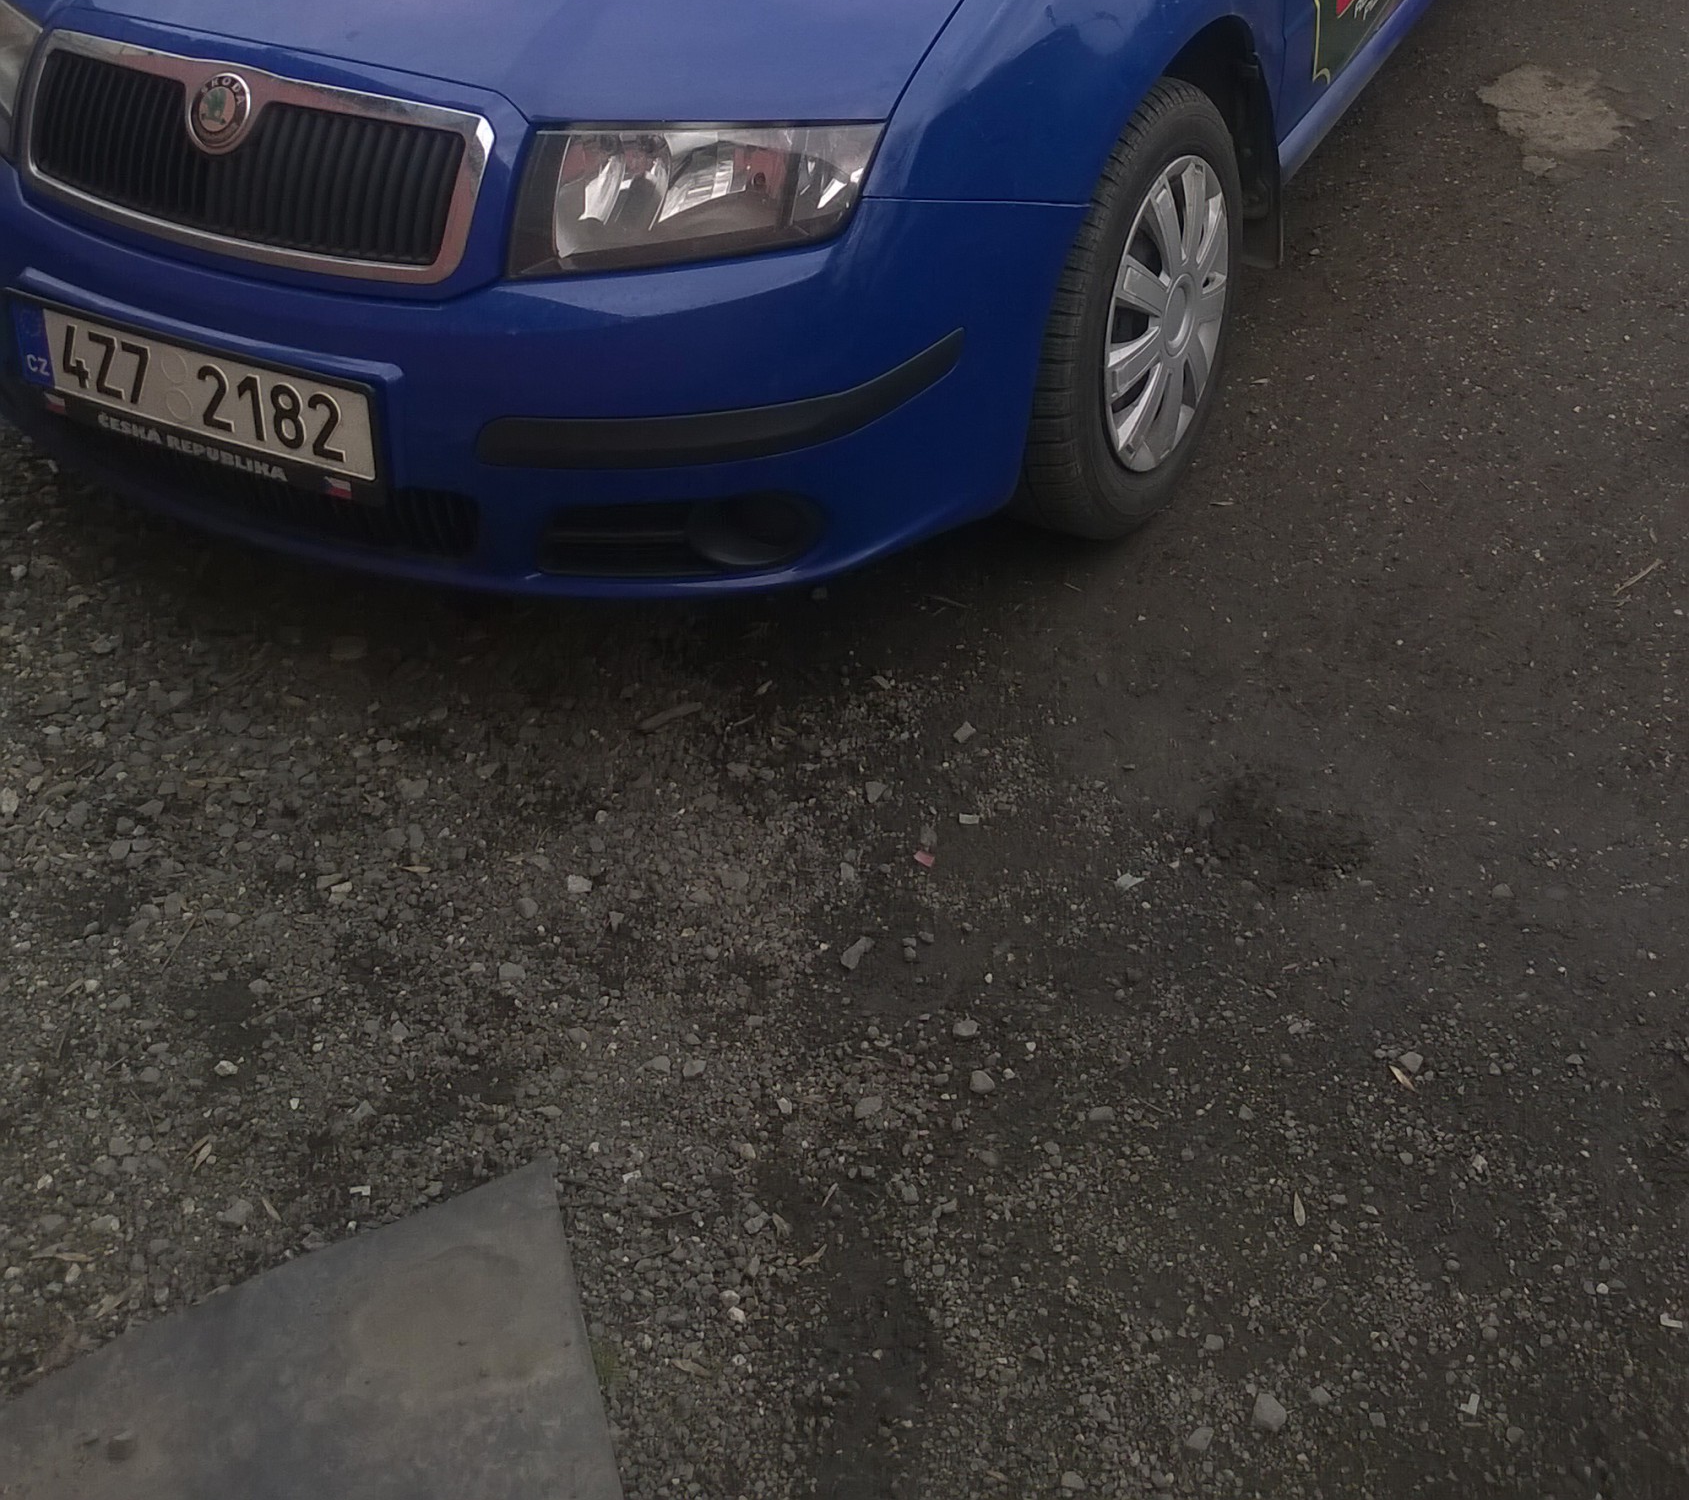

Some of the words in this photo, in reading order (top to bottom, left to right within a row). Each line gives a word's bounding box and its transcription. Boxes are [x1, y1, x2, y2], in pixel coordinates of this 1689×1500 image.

[26, 354, 51, 378] CZ
[62, 324, 151, 406] 4Z7
[197, 363, 348, 465] 2182
[166, 433, 289, 483] REPUBLIKA
